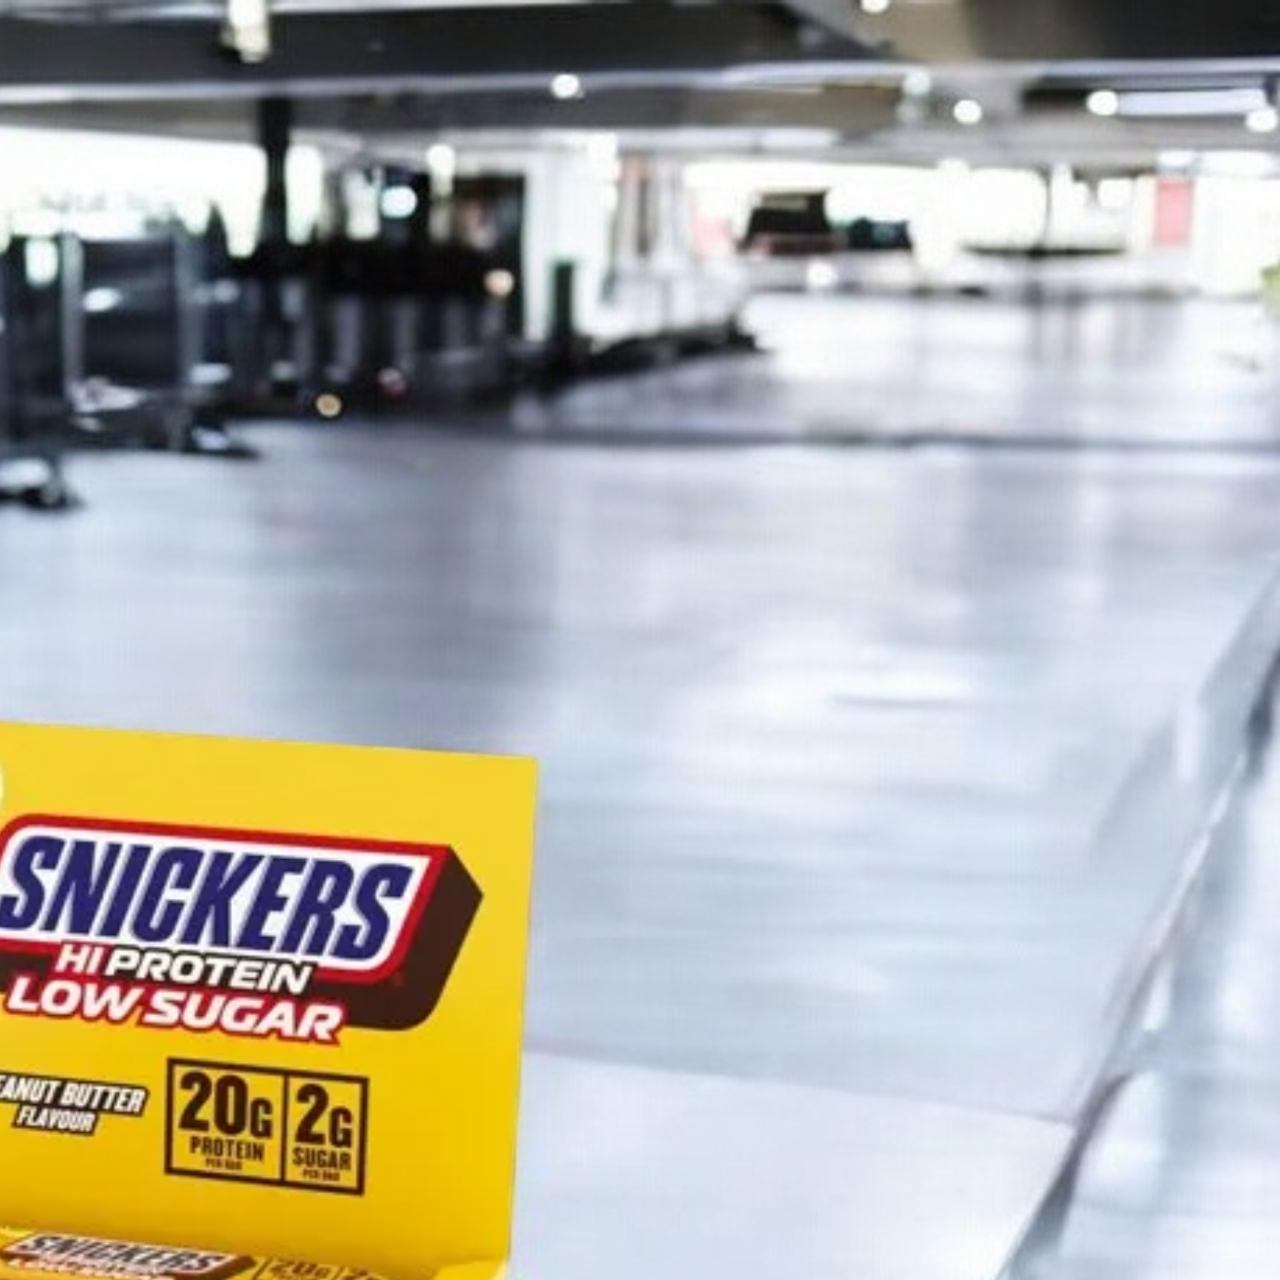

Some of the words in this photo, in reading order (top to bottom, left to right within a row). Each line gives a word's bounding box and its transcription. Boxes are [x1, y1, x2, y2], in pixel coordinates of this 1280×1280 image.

[56, 944, 103, 975] HI
[106, 949, 312, 994] PROTEIN
[7, 977, 146, 1020] LOW
[143, 988, 343, 1041] SUGAR
[61, 1081, 147, 1113] BUTTER
[179, 1071, 273, 1139] 20G
[295, 1083, 352, 1148] 2G
[16, 1105, 96, 1132] FLAVOUR
[190, 1136, 265, 1161] PROTEIN
[292, 1147, 352, 1170] SUGAR
